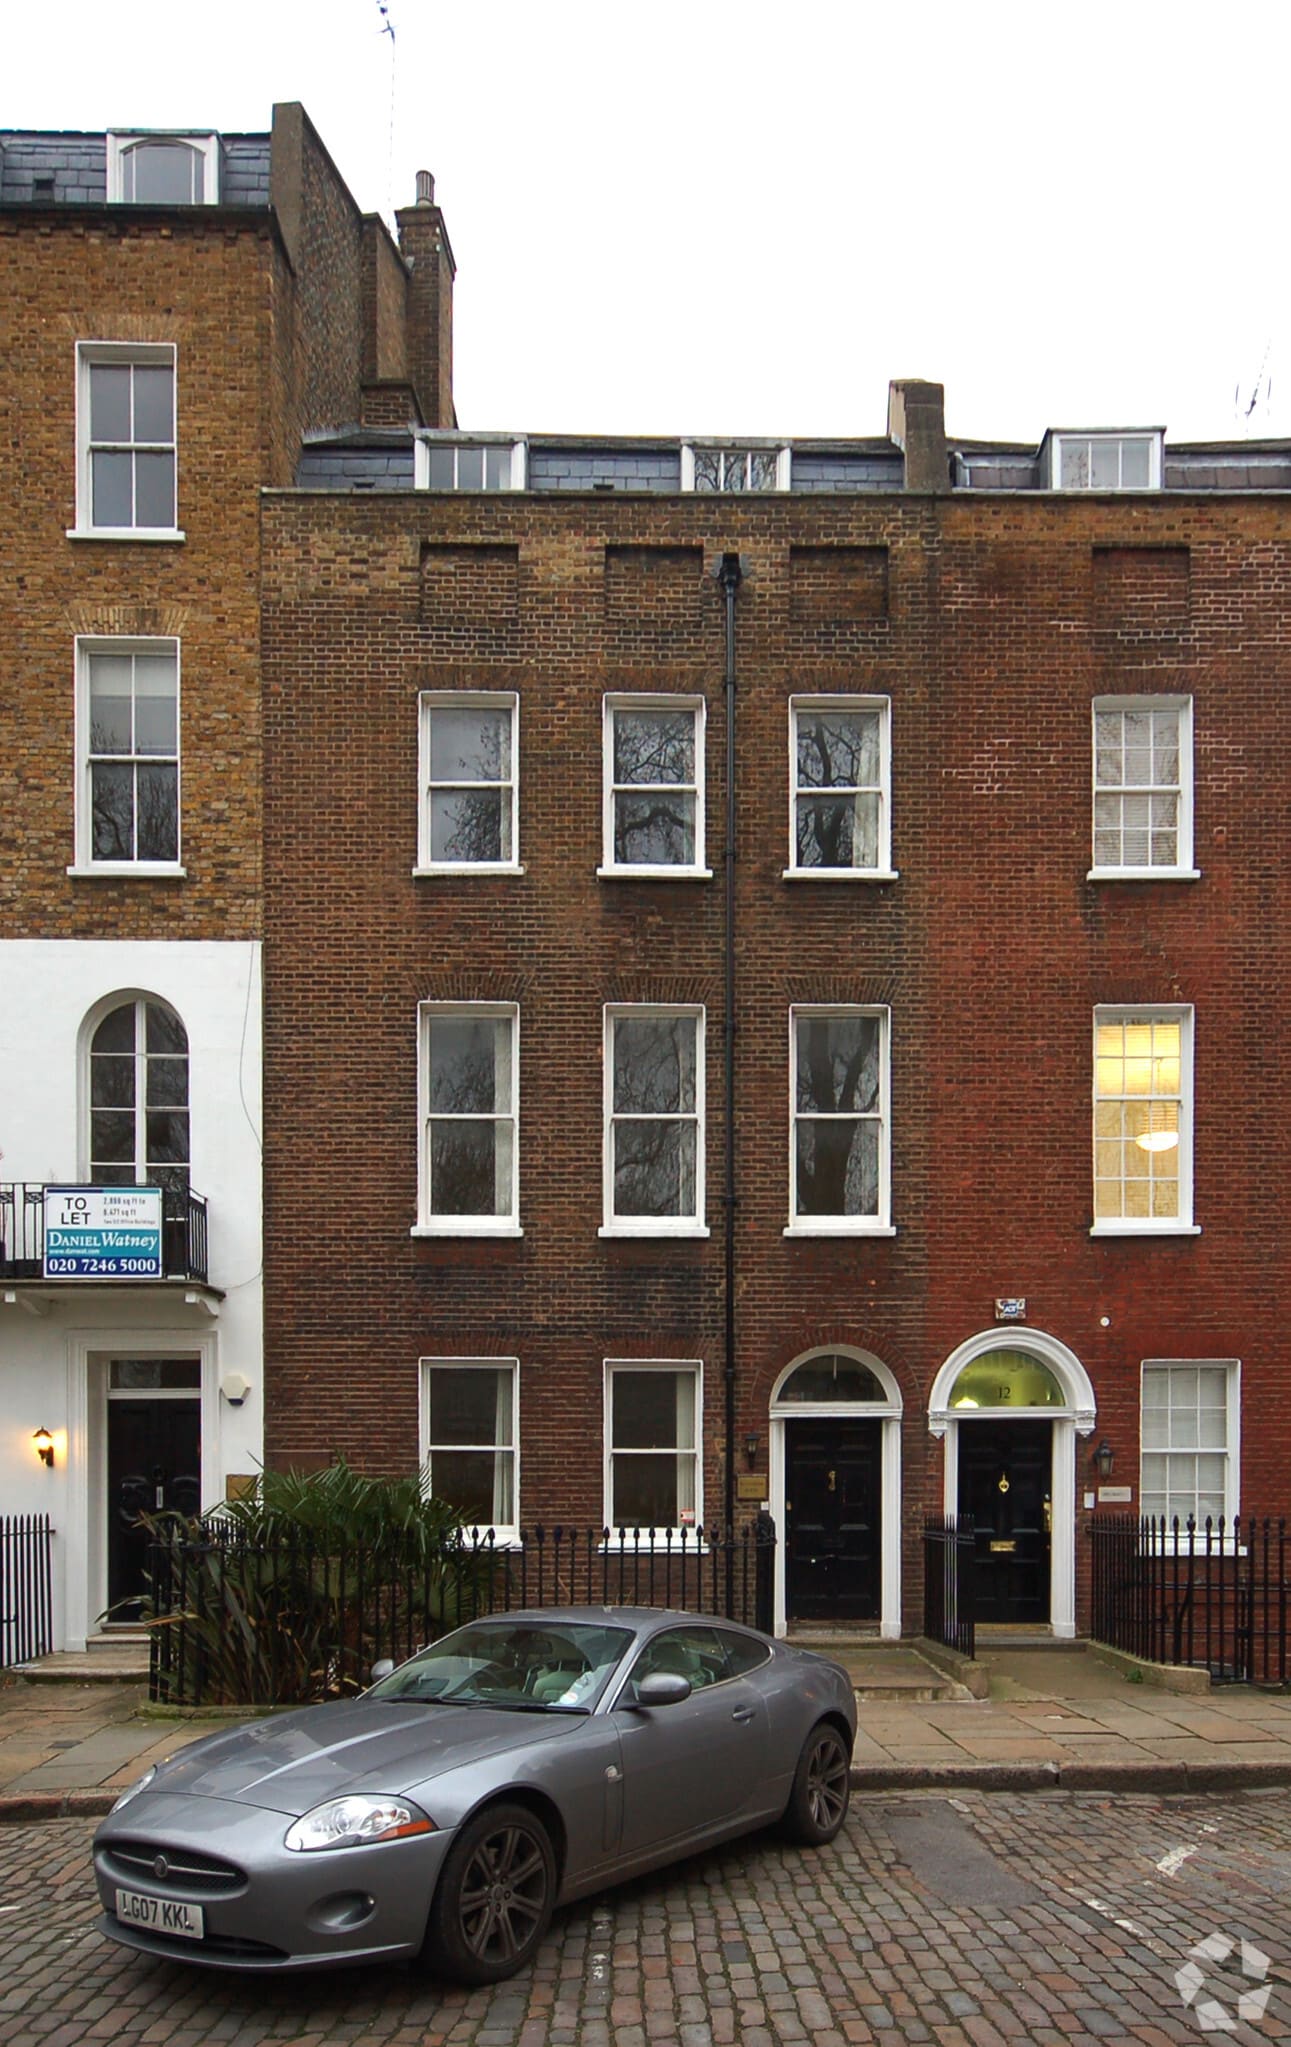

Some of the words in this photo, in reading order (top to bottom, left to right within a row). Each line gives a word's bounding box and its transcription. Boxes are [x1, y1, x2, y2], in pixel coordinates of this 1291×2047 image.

[64, 1197, 87, 1210] TO
[61, 1212, 91, 1225] LET
[49, 1231, 100, 1247] DANIEL
[101, 1231, 157, 1251] Watney
[49, 1259, 77, 1272] 020
[81, 1259, 117, 1272] 7246
[120, 1259, 156, 1272] 5000
[999, 1386, 1011, 1399] 12
[122, 1893, 158, 1923] LG07
[162, 1902, 194, 1931] KKL
